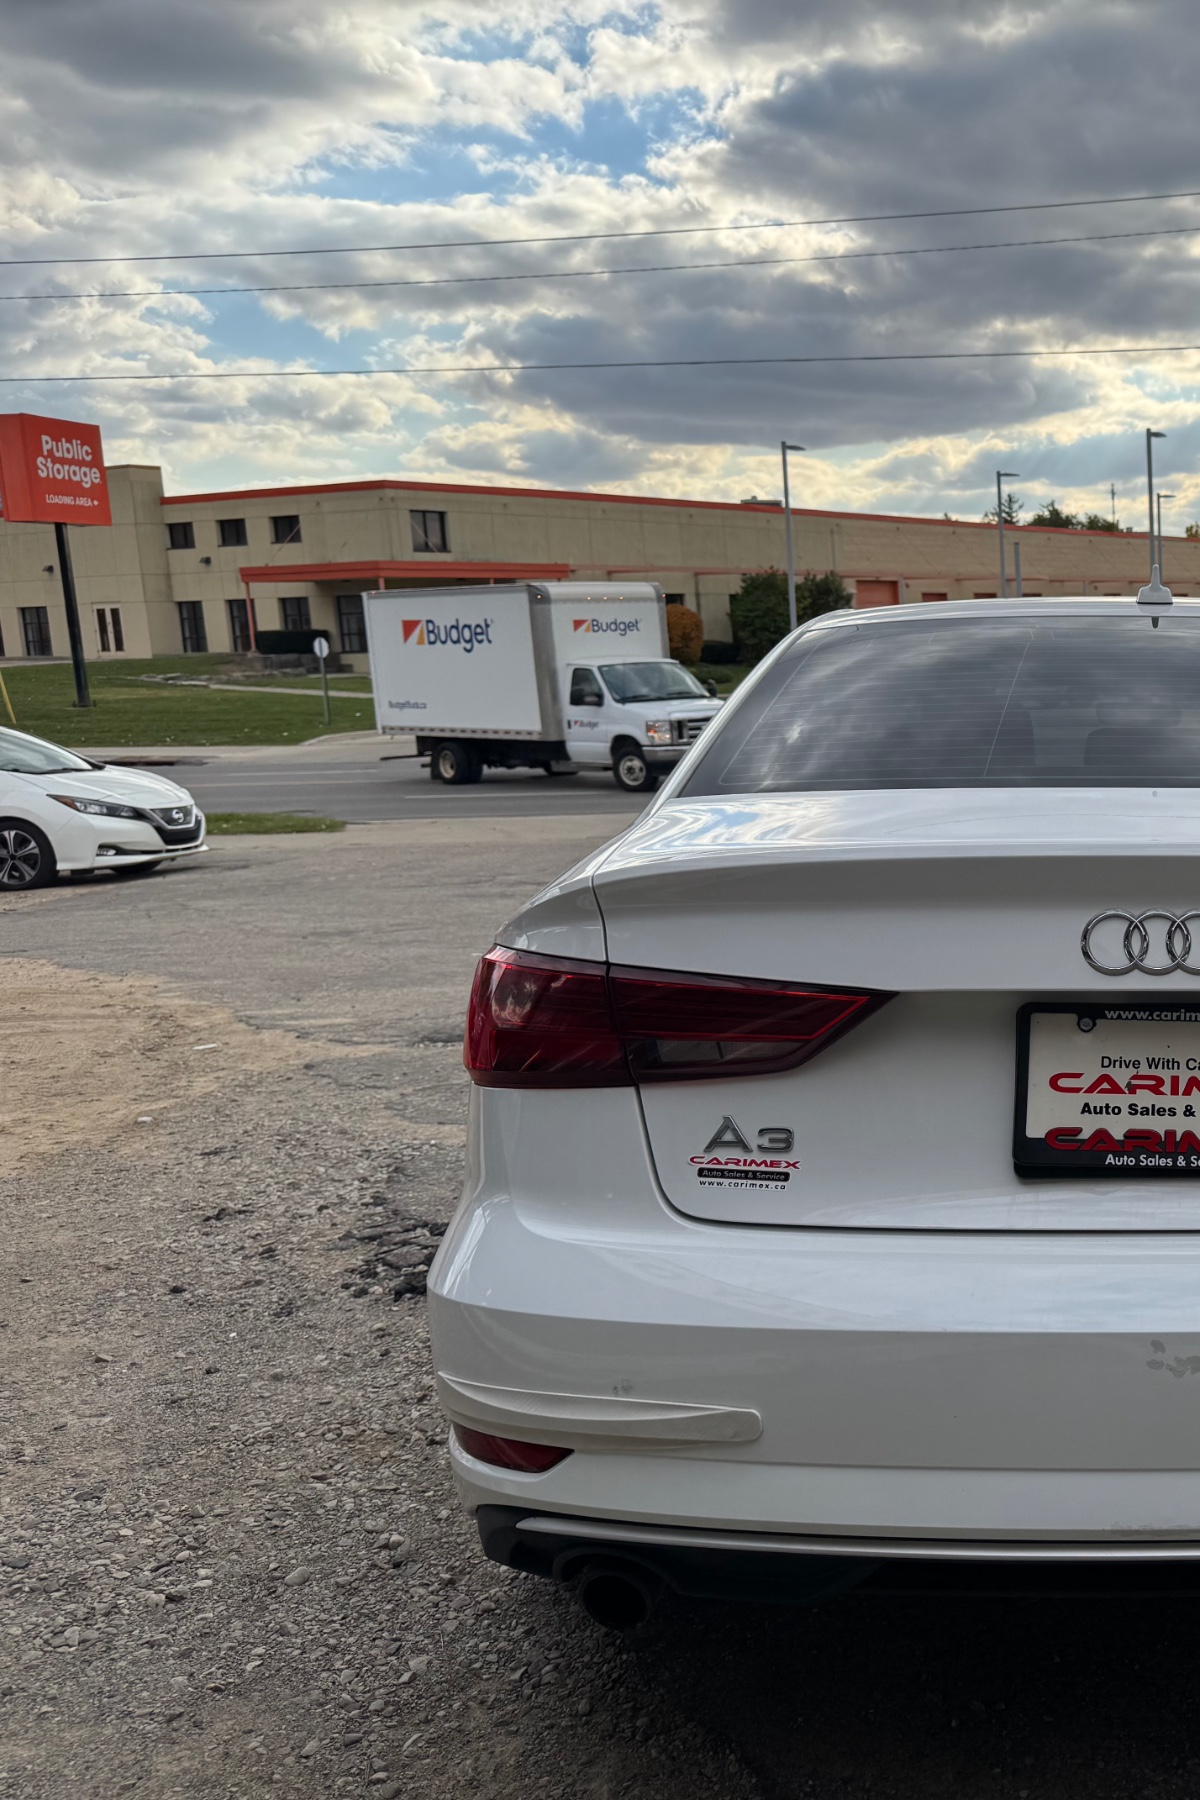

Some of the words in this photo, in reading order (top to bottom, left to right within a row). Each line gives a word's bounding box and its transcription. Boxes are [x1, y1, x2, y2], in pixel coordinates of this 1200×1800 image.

[41, 434, 92, 461] Public
[36, 456, 102, 488] Storage
[45, 494, 75, 505] LOADING
[76, 496, 92, 507] AREA
[591, 618, 641, 636] Budget
[425, 618, 493, 653] Budget
[1100, 1055, 1141, 1070] Drive
[1145, 1056, 1181, 1071] With
[1080, 1102, 1122, 1117] Auto
[1127, 1103, 1178, 1118] Sales
[1183, 1104, 1197, 1118] &
[703, 1114, 795, 1153] A3
[689, 1155, 802, 1169] CARIMEX
[1105, 1153, 1136, 1166] Auto
[1139, 1154, 1173, 1167] Sales
[1177, 1155, 1187, 1167] &
[702, 1169, 722, 1177] Auto
[724, 1170, 746, 1179] Sales
[756, 1172, 786, 1180] Service
[699, 1180, 787, 1190] www.carimex.ca
